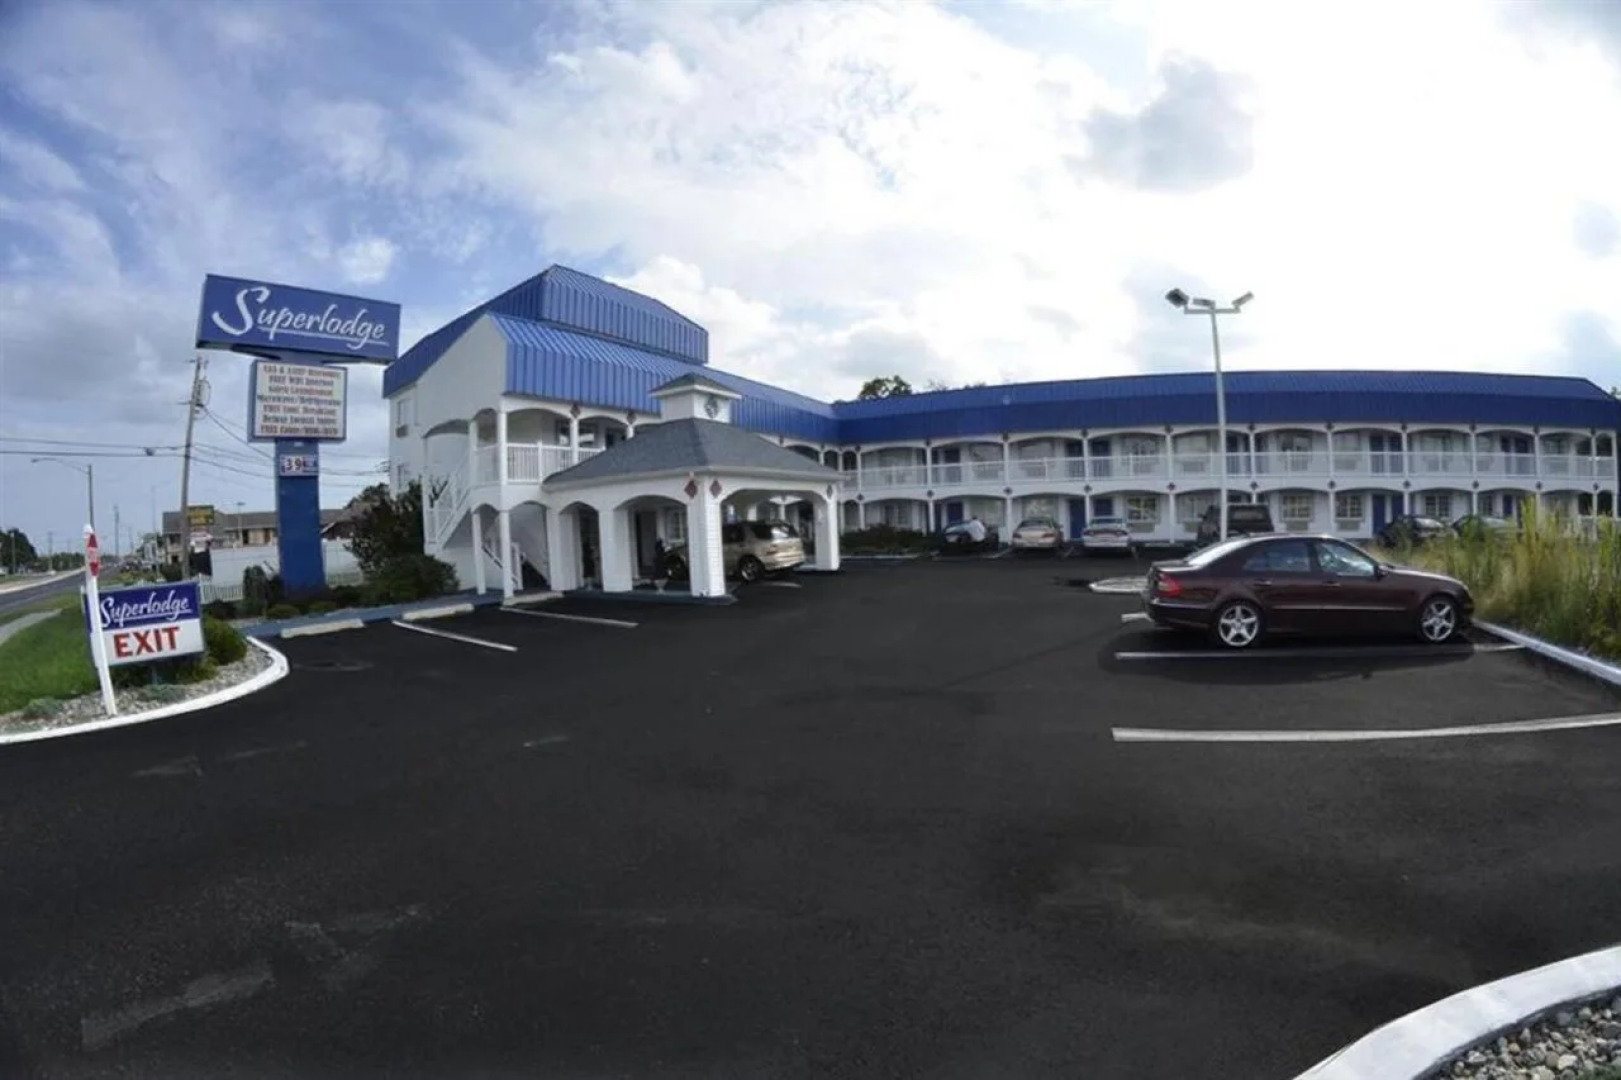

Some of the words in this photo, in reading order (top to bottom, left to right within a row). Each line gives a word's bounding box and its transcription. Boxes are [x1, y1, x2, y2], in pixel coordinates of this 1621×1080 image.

[211, 286, 388, 350] Superlodge
[101, 589, 191, 629] Superlodge
[113, 626, 180, 658] EXIT
